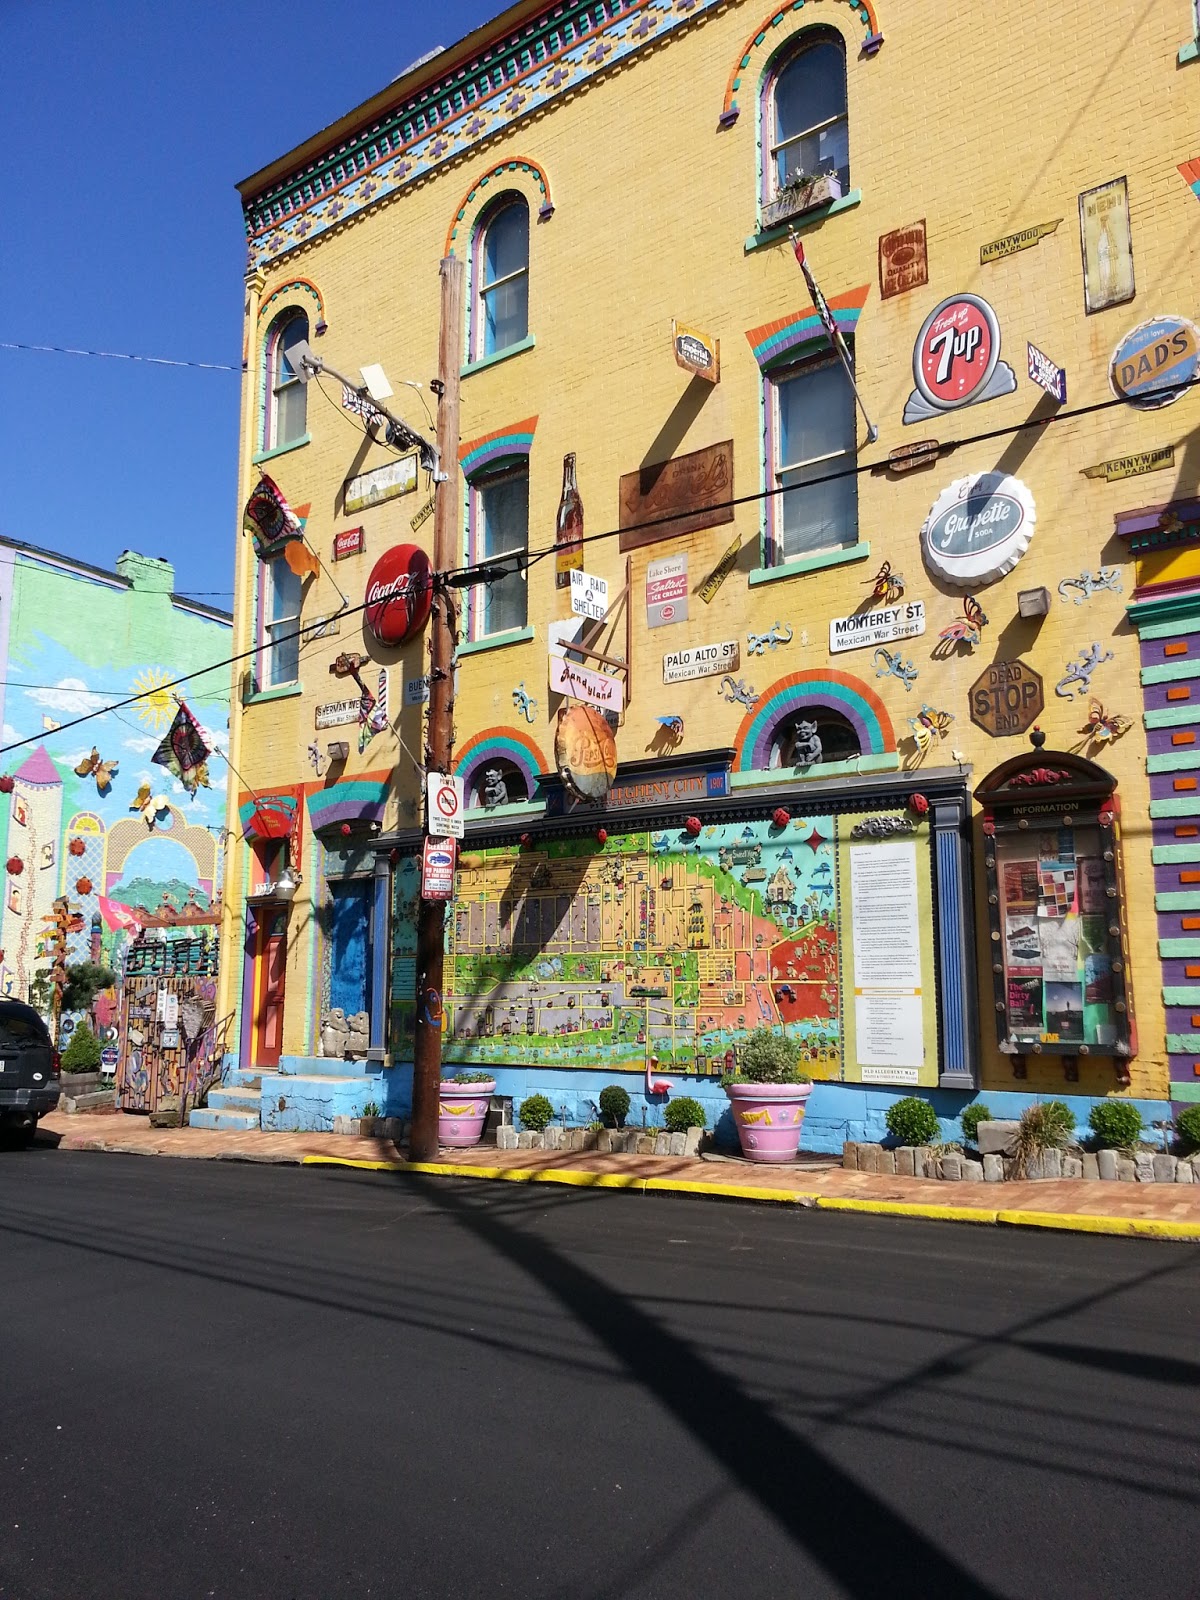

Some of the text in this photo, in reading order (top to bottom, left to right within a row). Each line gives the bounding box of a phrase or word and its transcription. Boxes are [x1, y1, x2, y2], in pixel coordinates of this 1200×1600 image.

[982, 228, 1039, 256] KENNYWOOD
[998, 243, 1022, 256] PARK
[887, 260, 920, 277] QUALITY
[1150, 328, 1165, 338] love
[1121, 329, 1188, 388] DAD'S
[1106, 449, 1172, 474] KENNYWOOD
[1125, 464, 1152, 476] PARK
[940, 501, 1011, 548] Grapette
[974, 528, 993, 538] SODA
[560, 558, 577, 567] COLA
[648, 564, 681, 578] Lake Shore
[571, 571, 606, 594] AIR RAID
[651, 589, 683, 601] ICE CREAM
[573, 598, 605, 619] SHELTER
[835, 608, 901, 634] MONTEREY
[837, 623, 919, 647] Mexican War Street
[667, 653, 690, 667] PALO
[695, 647, 718, 662] ALTO
[668, 668, 696, 680] Mexican
[698, 665, 711, 674] War
[989, 666, 1022, 685] DEAD
[408, 679, 429, 693] BUEN
[974, 681, 1038, 716] STOP
[317, 701, 347, 717] SHERMAN
[995, 714, 1020, 730] END
[609, 776, 706, 801] LEGHENY CITY
[709, 777, 724, 790] 1907
[1013, 802, 1079, 815] INFORMATION
[733, 850, 747, 859] Sweet
[1009, 983, 1023, 991] The
[1009, 991, 1030, 1000] Dirty
[1010, 999, 1025, 1007] Ball
